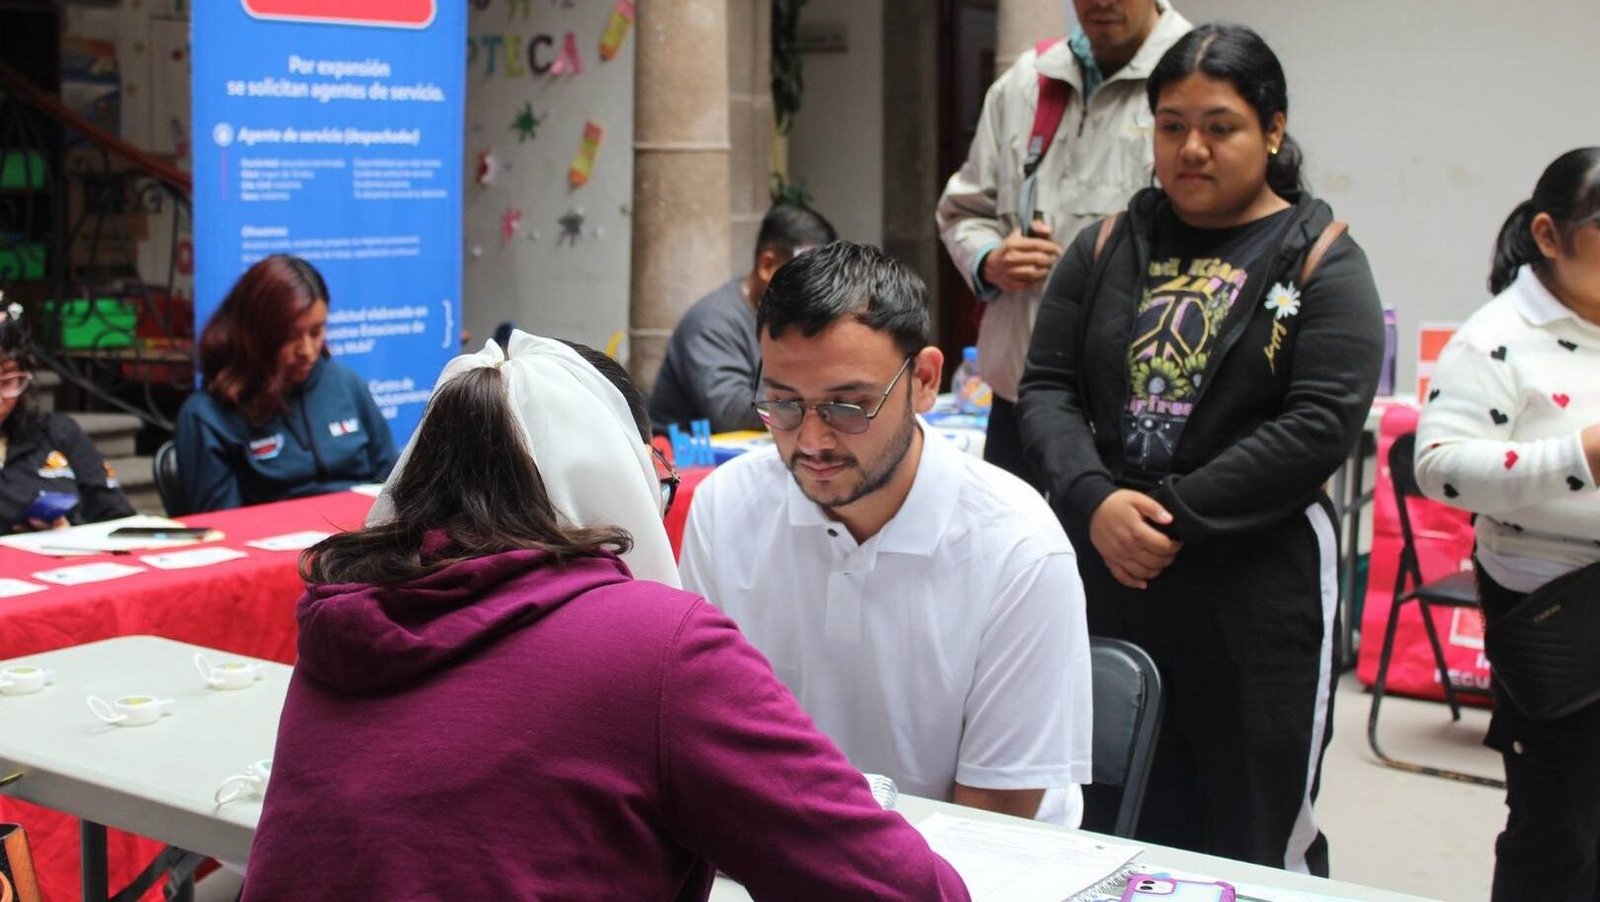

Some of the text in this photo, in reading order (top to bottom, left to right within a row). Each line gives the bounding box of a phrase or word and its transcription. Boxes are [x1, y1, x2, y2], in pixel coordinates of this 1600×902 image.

[288, 54, 391, 80] Por expansión
[226, 80, 245, 96] se
[248, 77, 309, 97] solicitan
[311, 83, 366, 103] agentes
[368, 81, 389, 99] de
[237, 127, 281, 146] Agente
[282, 127, 297, 143] de
[299, 127, 342, 143] servicio
